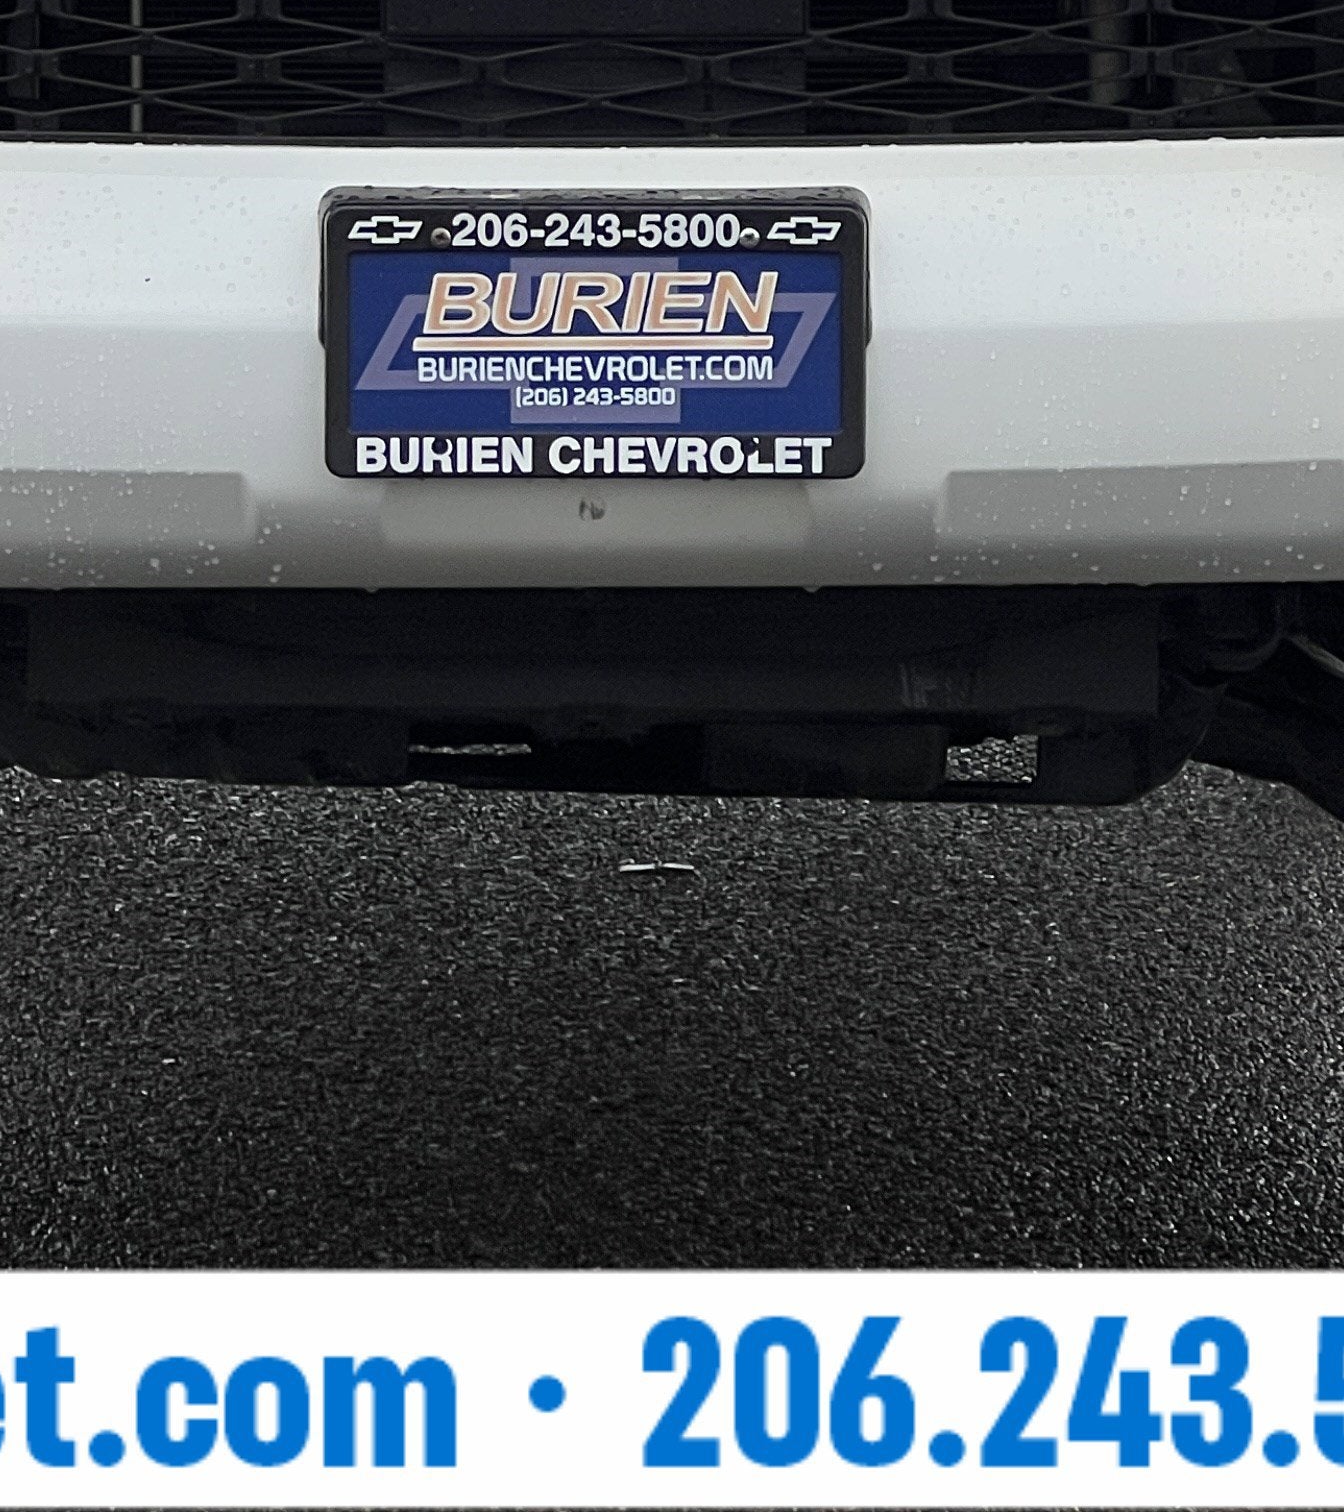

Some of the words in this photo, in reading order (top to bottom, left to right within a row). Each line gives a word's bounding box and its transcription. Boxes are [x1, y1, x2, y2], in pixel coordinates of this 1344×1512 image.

[452, 213, 740, 248] 206-243-5800
[423, 271, 778, 334] BURIEN
[418, 356, 773, 383] BURIENCHEVROLET.COM
[515, 387, 569, 407] (206)
[573, 387, 675, 406] 243-5800
[356, 437, 533, 474] BURIEN
[548, 437, 832, 474] CHEVROLET
